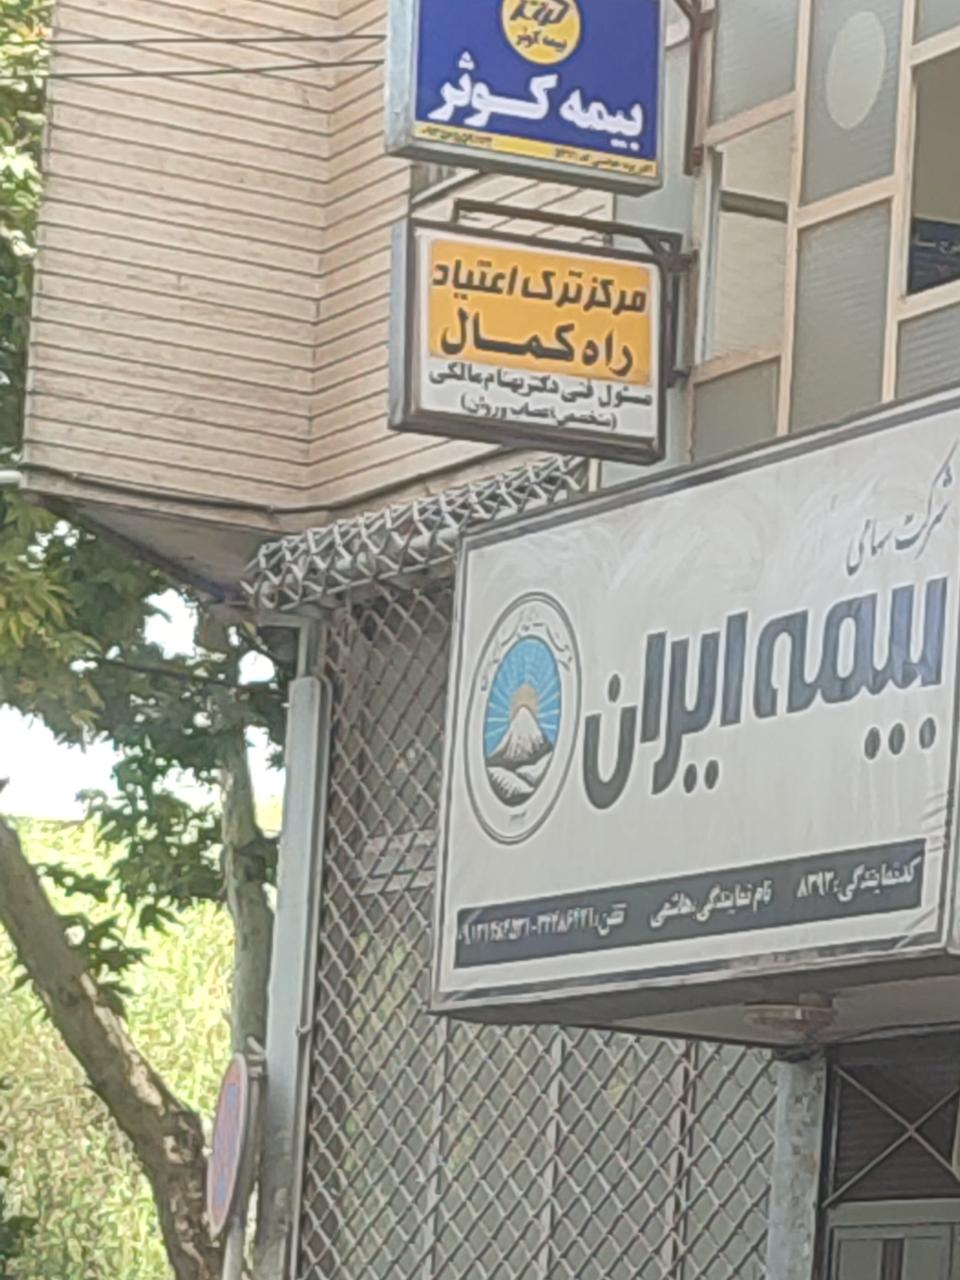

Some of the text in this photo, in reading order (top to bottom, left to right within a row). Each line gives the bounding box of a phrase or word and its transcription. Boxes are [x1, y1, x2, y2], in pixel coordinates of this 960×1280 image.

[428, 51, 644, 152] بیمه کوثر
[432, 259, 647, 316] مرکز ترک اعتیاد
[428, 360, 483, 385] مالکی
[440, 306, 634, 376] راه کمال
[519, 373, 559, 398] دکتر
[561, 377, 595, 403] فنی
[846, 437, 959, 577] شرکت سهامی
[582, 576, 949, 811] بیمه ایران
